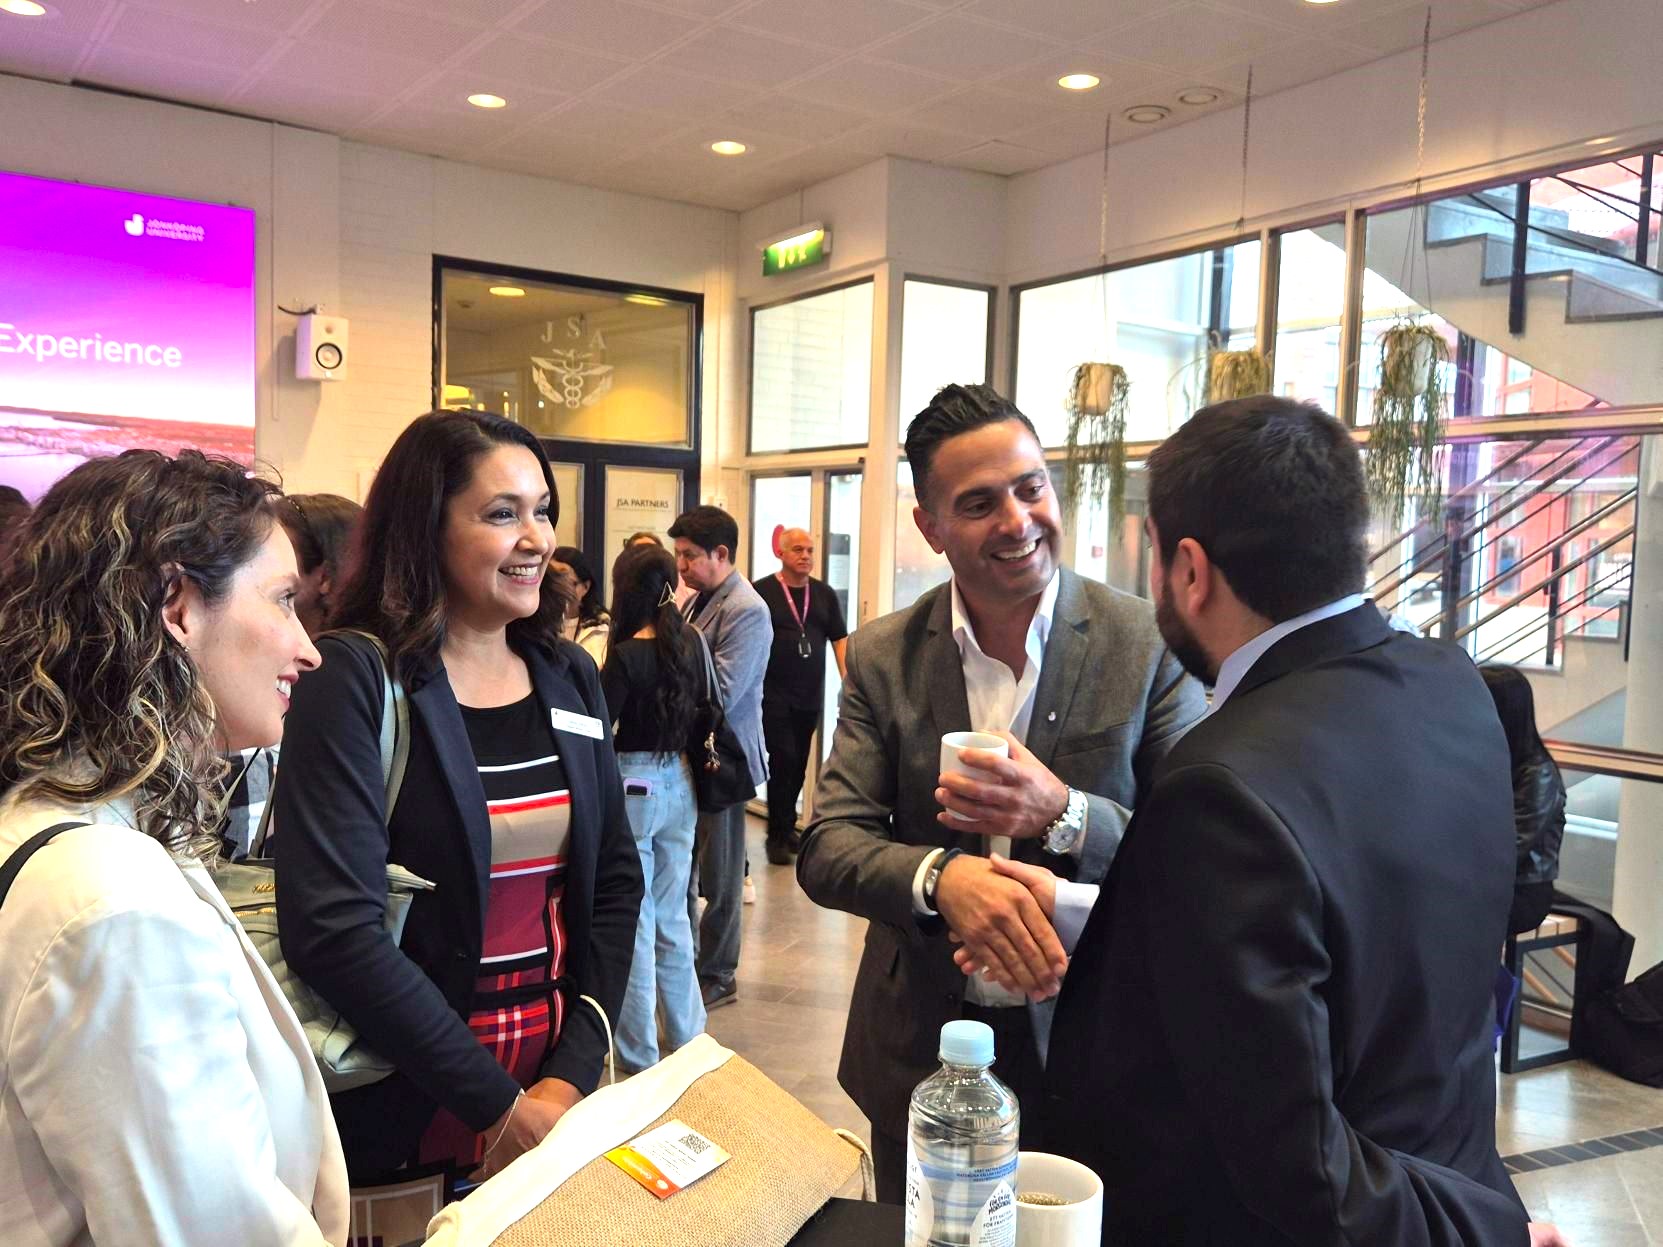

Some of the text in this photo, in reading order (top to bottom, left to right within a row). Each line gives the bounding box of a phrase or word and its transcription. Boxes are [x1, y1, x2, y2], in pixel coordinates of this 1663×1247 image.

[0, 323, 183, 368] Experience
[616, 498, 669, 509] JSA PARTNERS
